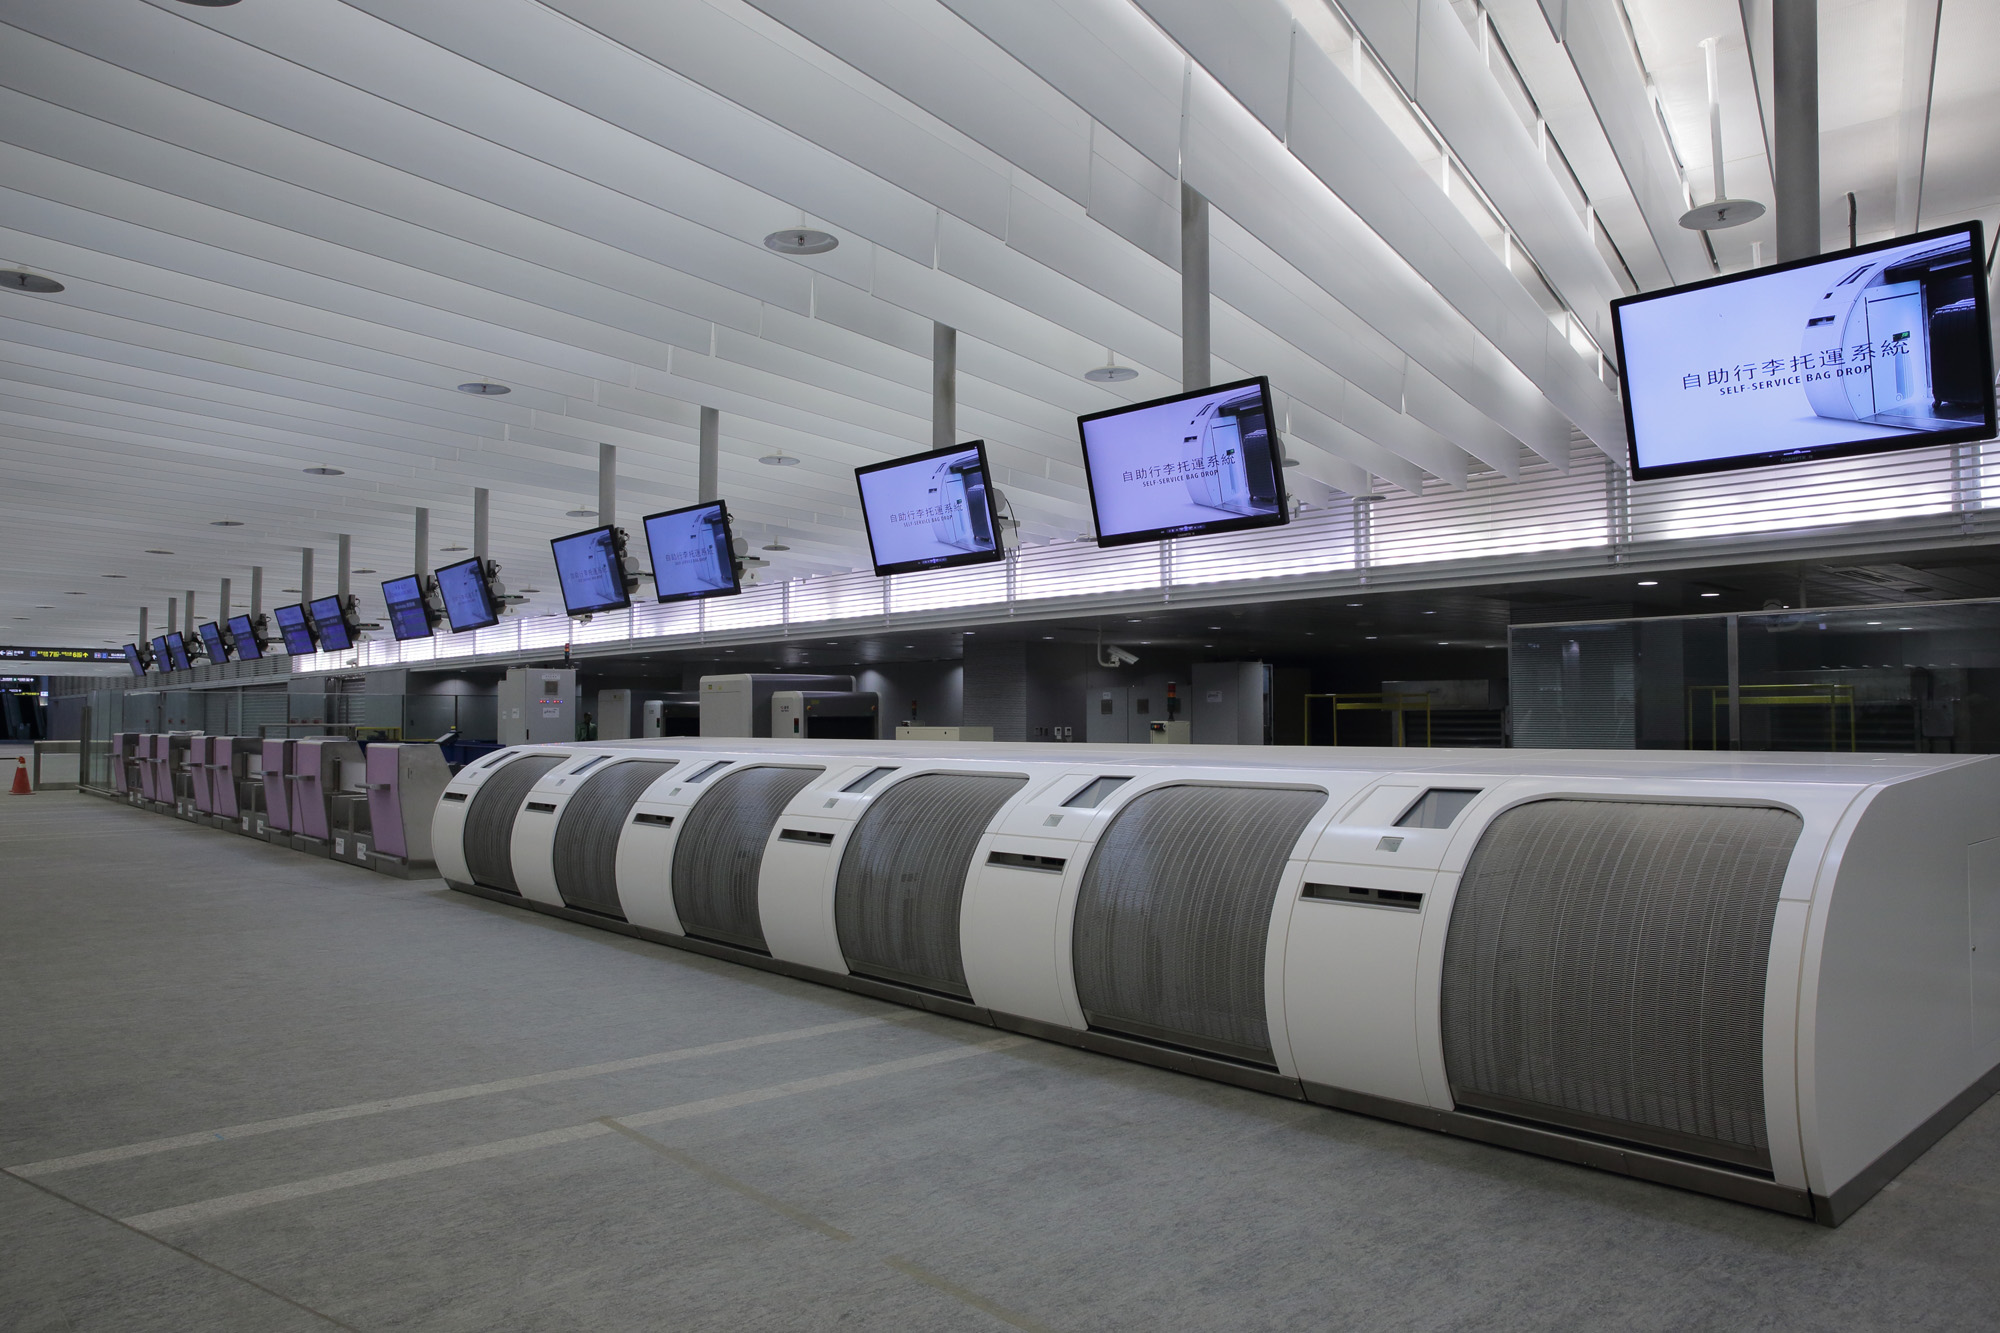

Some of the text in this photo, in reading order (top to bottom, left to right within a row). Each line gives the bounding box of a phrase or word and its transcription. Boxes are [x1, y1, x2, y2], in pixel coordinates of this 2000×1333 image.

[1682, 339, 1910, 390] 自助行李托運系統
[1719, 364, 1871, 396] SELF-SERVICE BAG DROP
[1122, 455, 1236, 482] 自助行李托運系統
[1142, 475, 1184, 488] SELF-SERVICE
